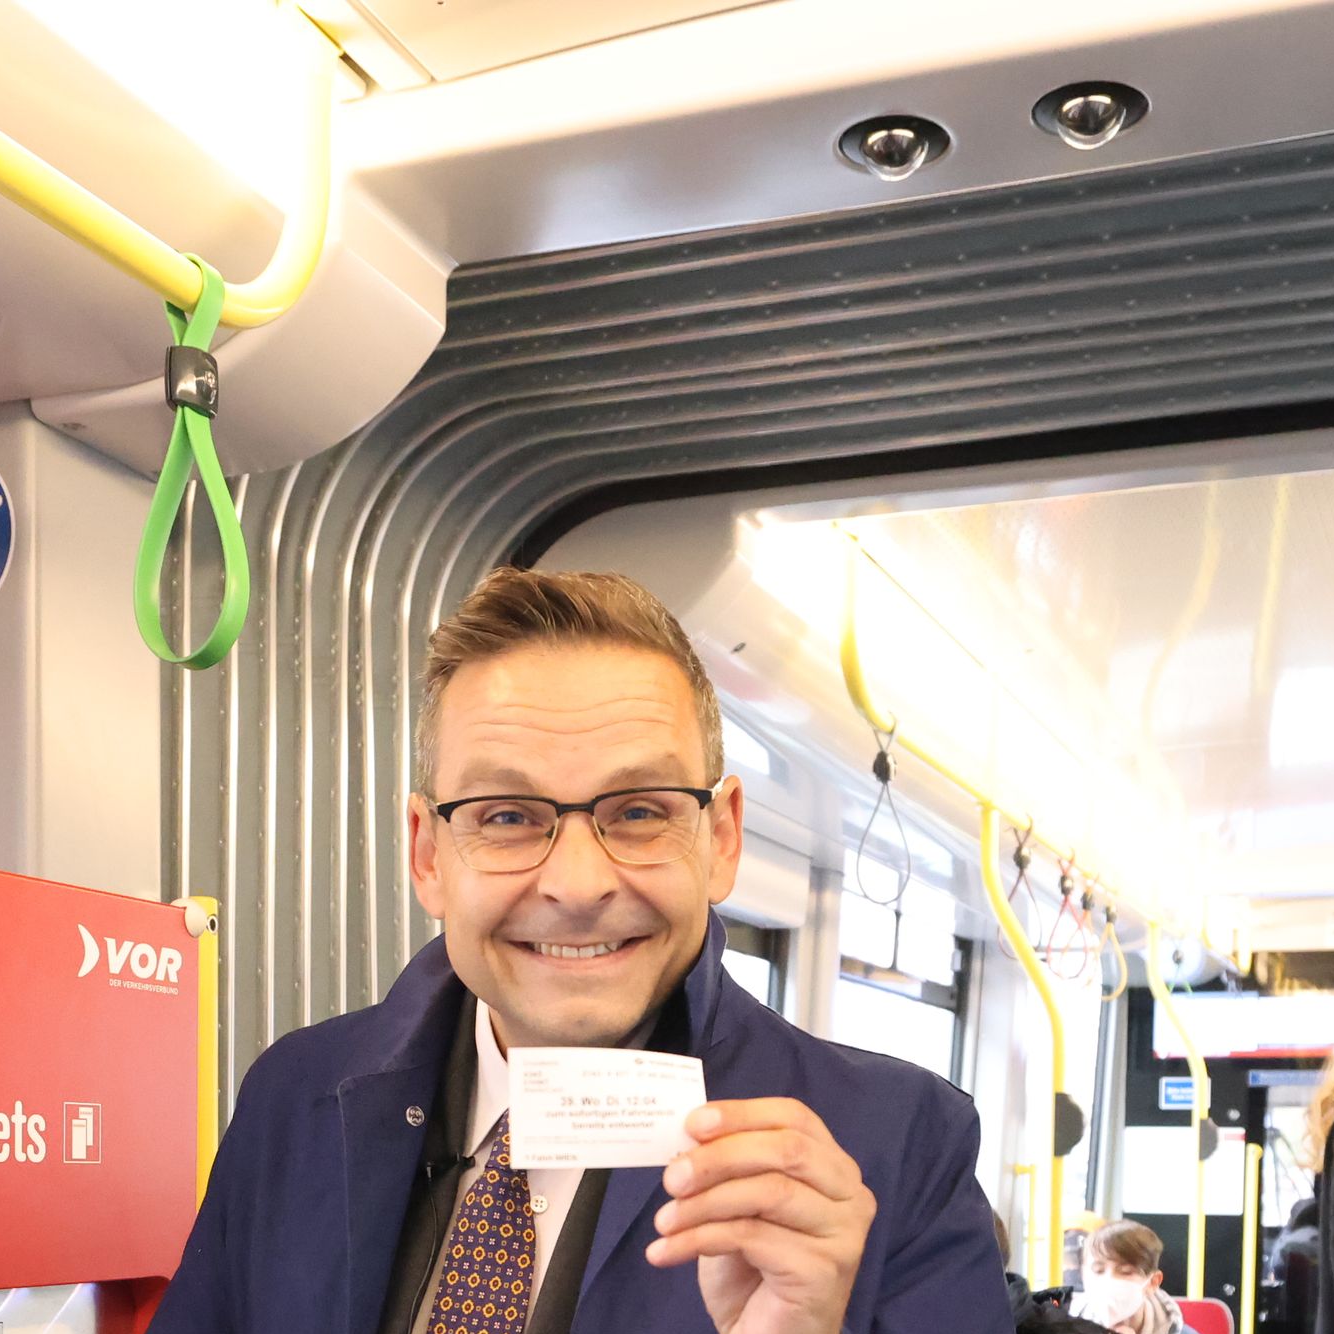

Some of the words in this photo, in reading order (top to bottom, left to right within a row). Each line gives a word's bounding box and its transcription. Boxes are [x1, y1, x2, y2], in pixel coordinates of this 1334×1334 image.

[103, 936, 183, 983] VOR
[109, 978, 122, 987] DER
[123, 980, 179, 995] VERKEHRSVERBUND
